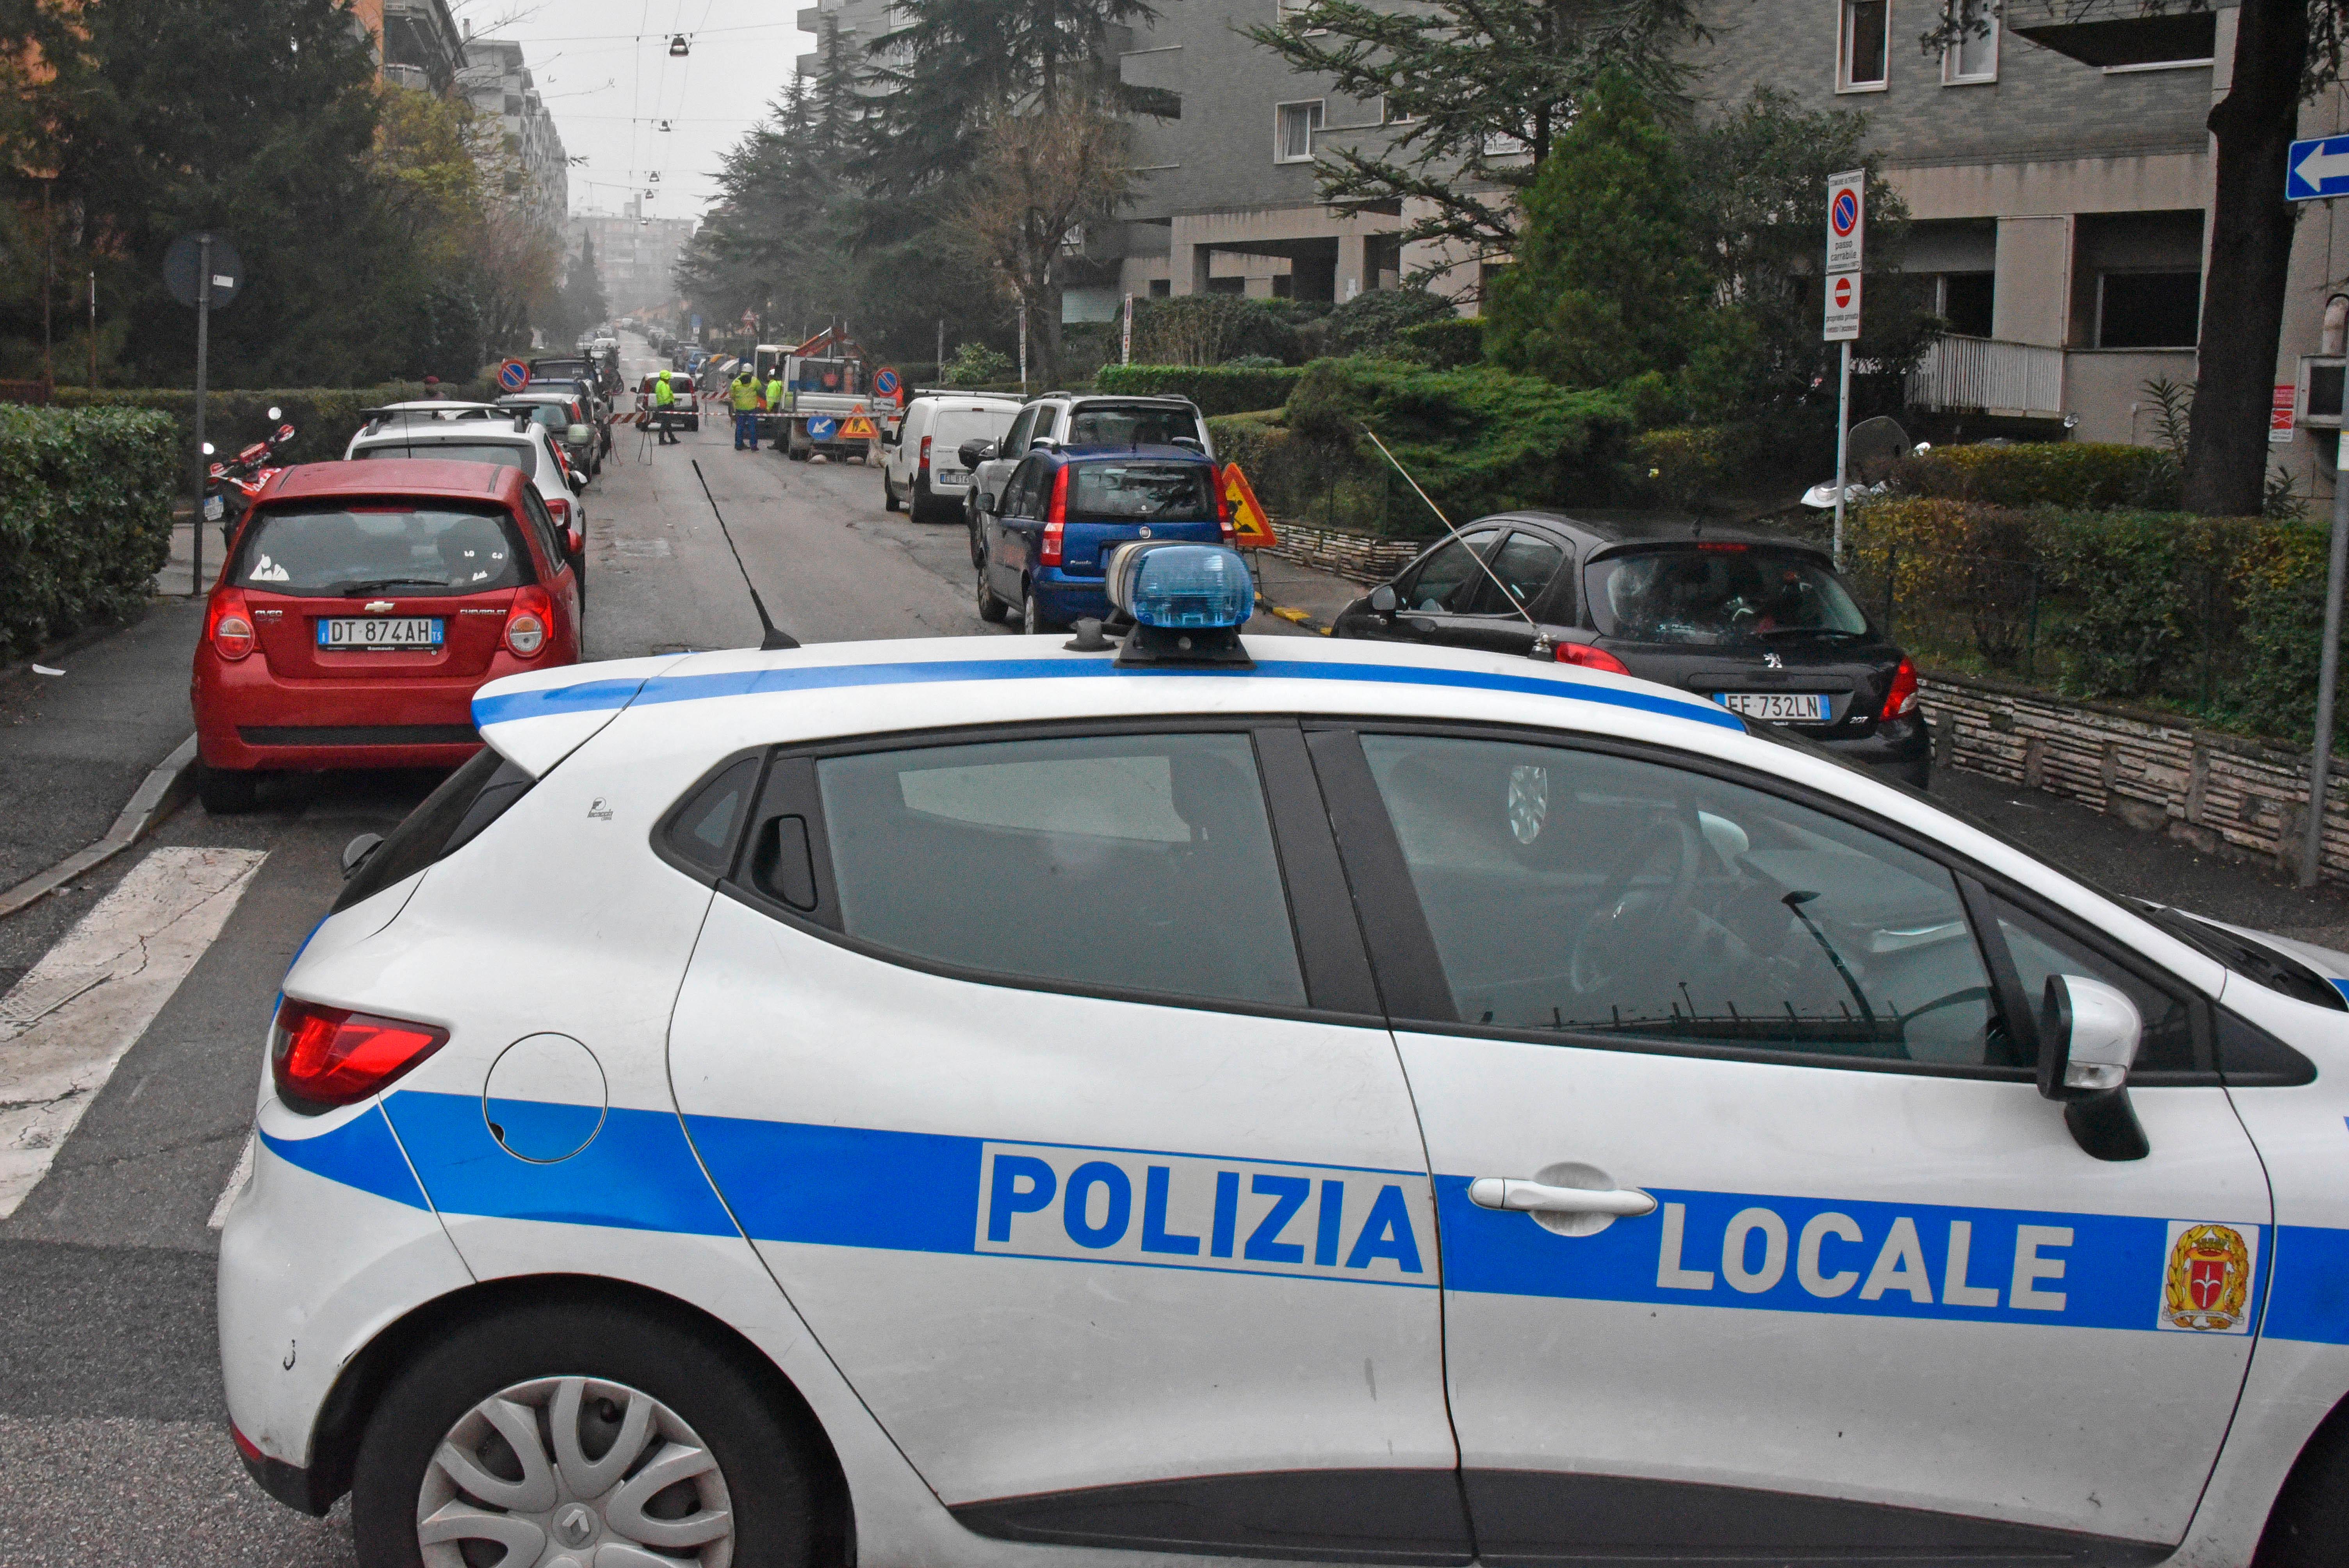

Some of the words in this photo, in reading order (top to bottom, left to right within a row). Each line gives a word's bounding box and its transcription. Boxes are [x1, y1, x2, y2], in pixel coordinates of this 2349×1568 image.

[1830, 250, 1857, 261] carrabile
[1835, 241, 1853, 250] passo
[332, 621, 356, 642] DT
[365, 621, 429, 641] 874AH
[1759, 696, 1818, 717] 732LN
[987, 1154, 1424, 1273] POLIZIA
[1656, 1203, 2075, 1312] LOCALE
